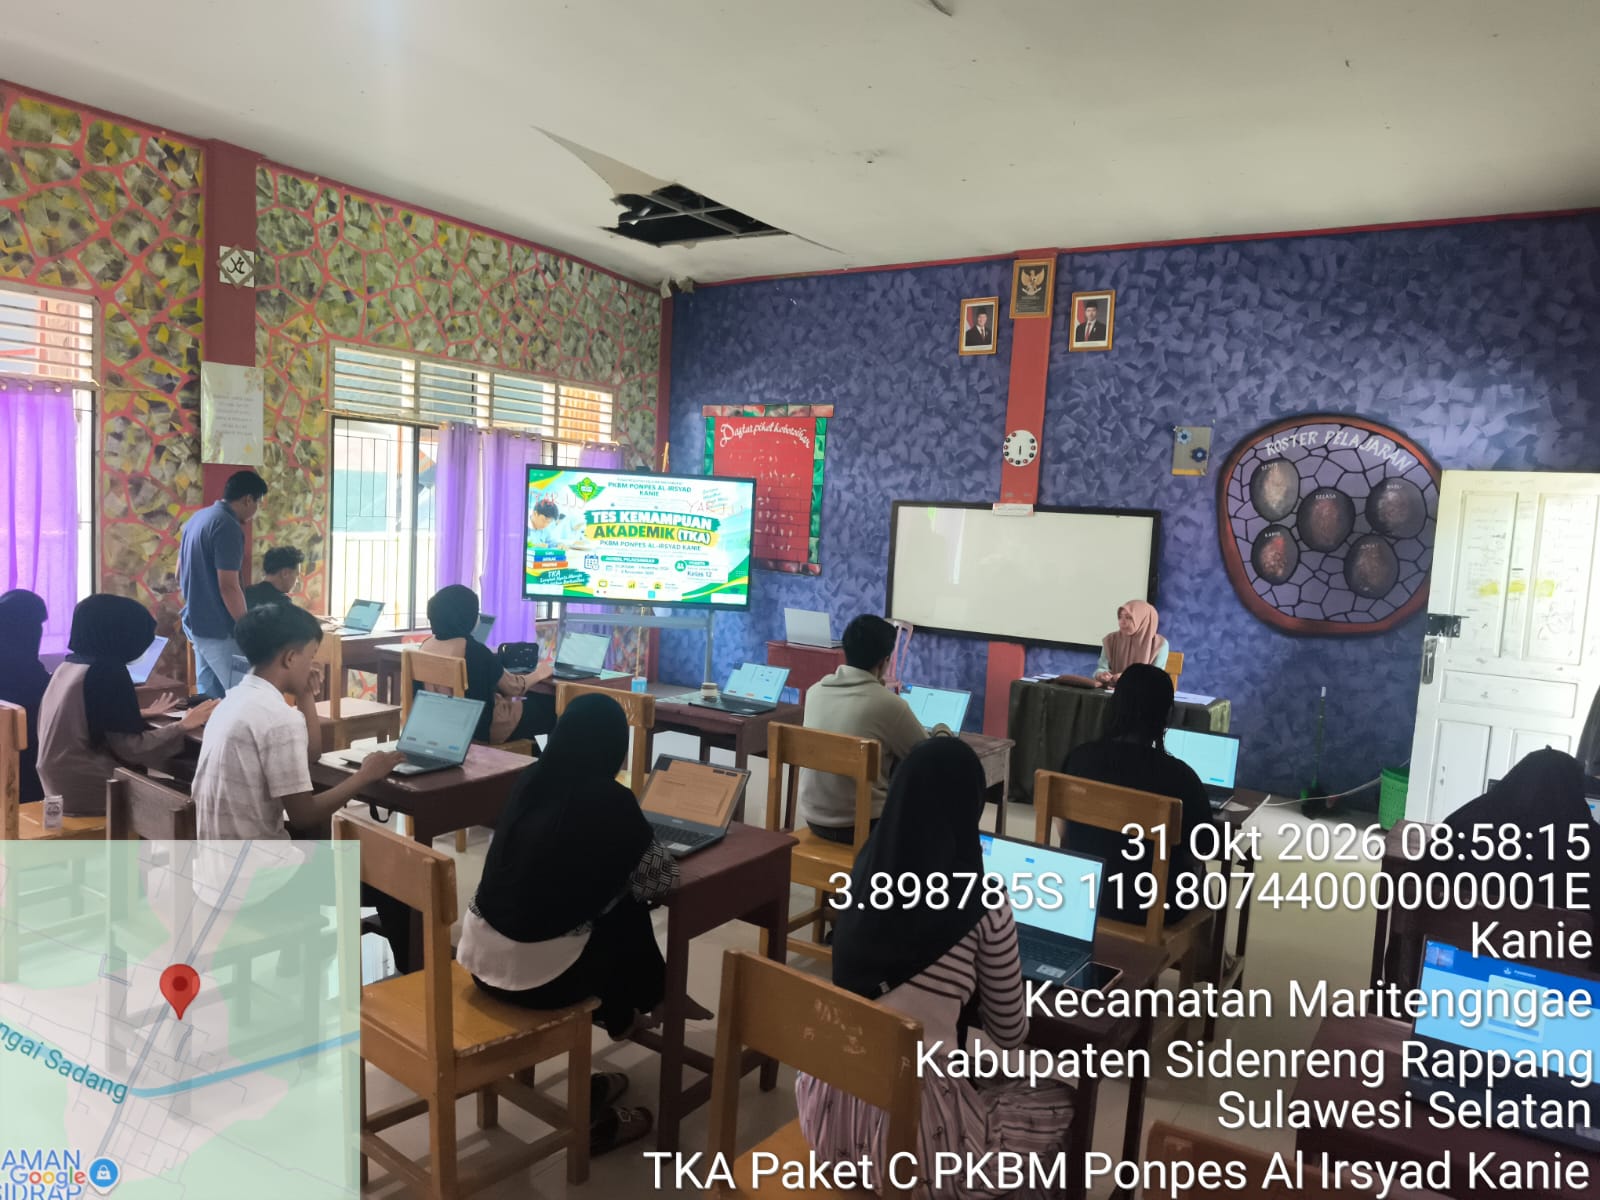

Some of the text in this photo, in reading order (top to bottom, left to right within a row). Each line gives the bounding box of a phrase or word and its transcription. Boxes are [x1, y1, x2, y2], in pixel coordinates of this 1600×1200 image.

[1265, 430, 1413, 472] ROSTER PELAJARAN
[629, 483, 656, 491] PONPES
[591, 511, 712, 531] TES KEMAMPUAN
[593, 525, 711, 545] AKADEMIK (TKA)
[620, 541, 646, 549] PONPES
